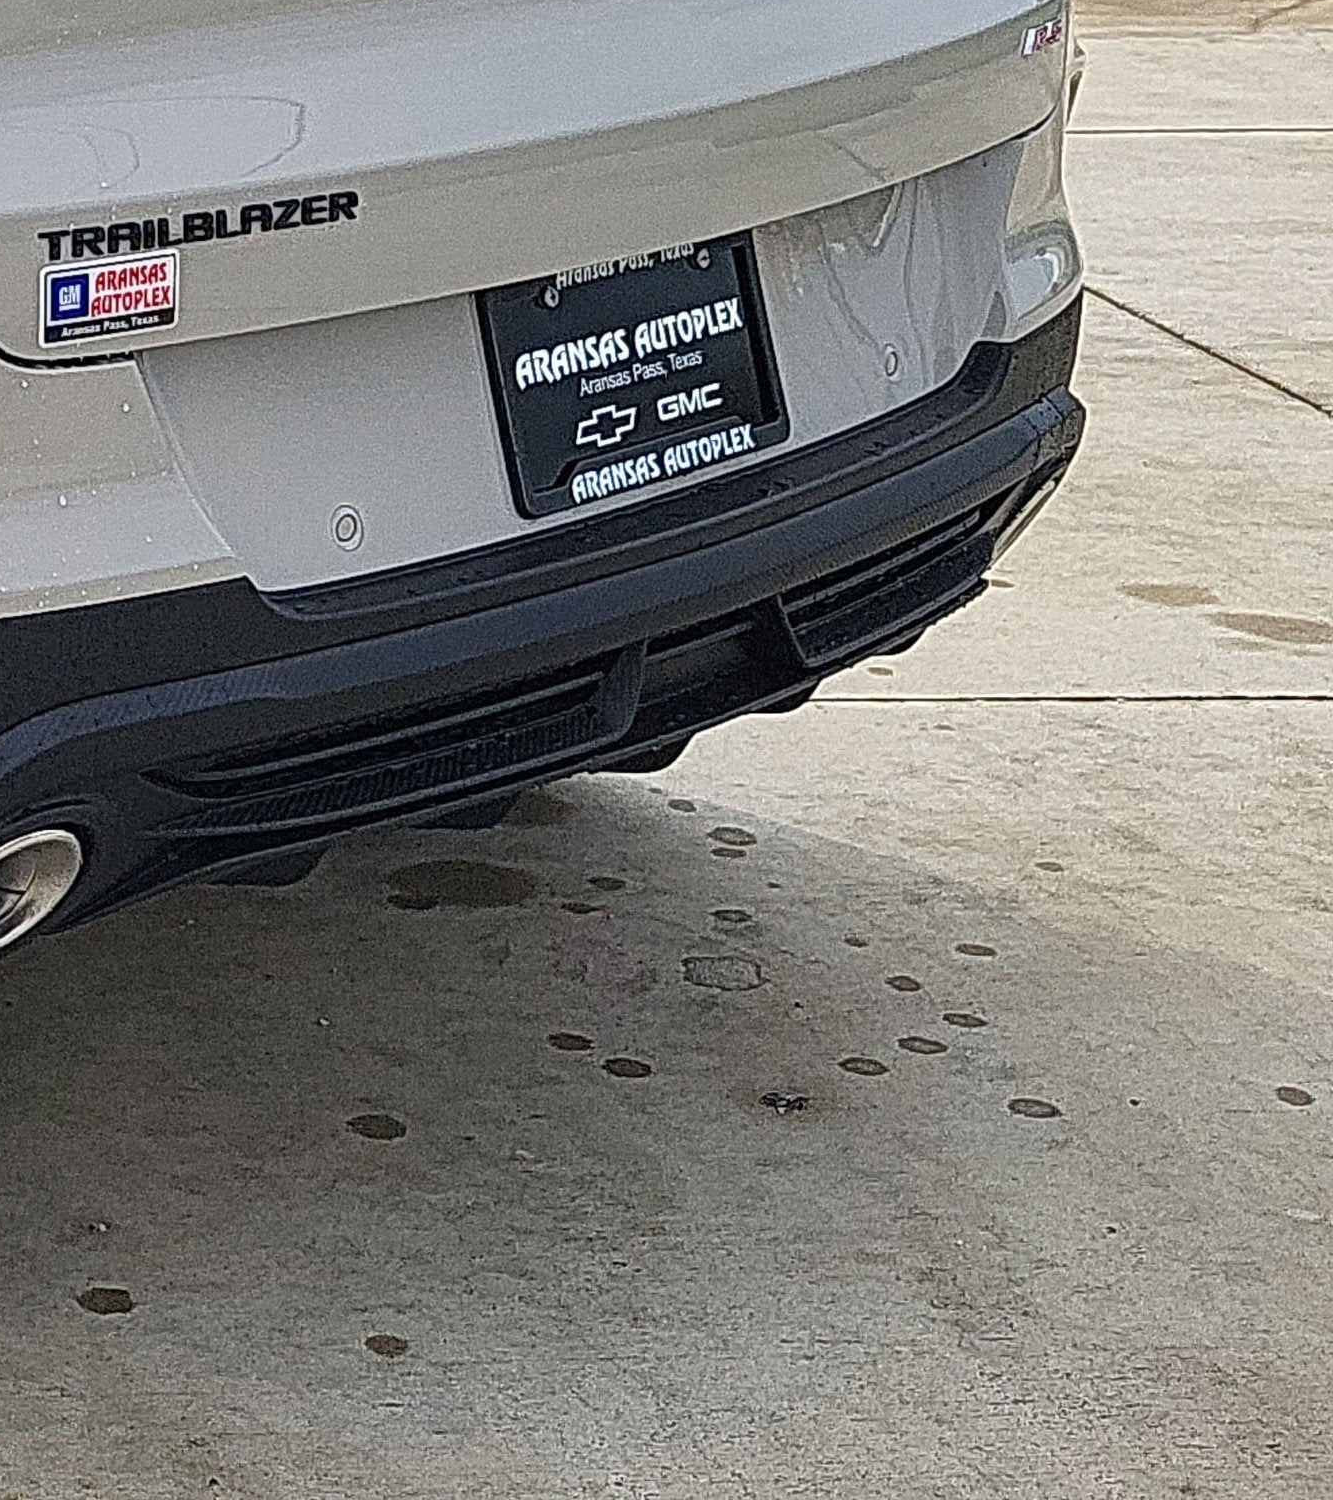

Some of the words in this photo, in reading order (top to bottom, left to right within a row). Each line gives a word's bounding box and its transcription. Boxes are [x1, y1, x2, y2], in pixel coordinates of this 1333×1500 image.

[37, 190, 359, 261] TRAILBLAZER
[58, 283, 82, 312] GM
[94, 262, 168, 294] ARANSAS
[90, 285, 171, 318] AUTOPLEX
[61, 323, 102, 338] Aransas
[102, 319, 130, 332] Pass,
[130, 314, 160, 327] Texas
[515, 328, 630, 392] ARANSAS
[633, 297, 744, 360] AUTOPLEX
[579, 368, 632, 398] Aransas
[632, 359, 668, 379] Pass,
[667, 349, 705, 372] Texas
[656, 382, 723, 422] GMC
[571, 452, 662, 505] ARANSAS
[663, 423, 756, 477] AUTOPLEX
